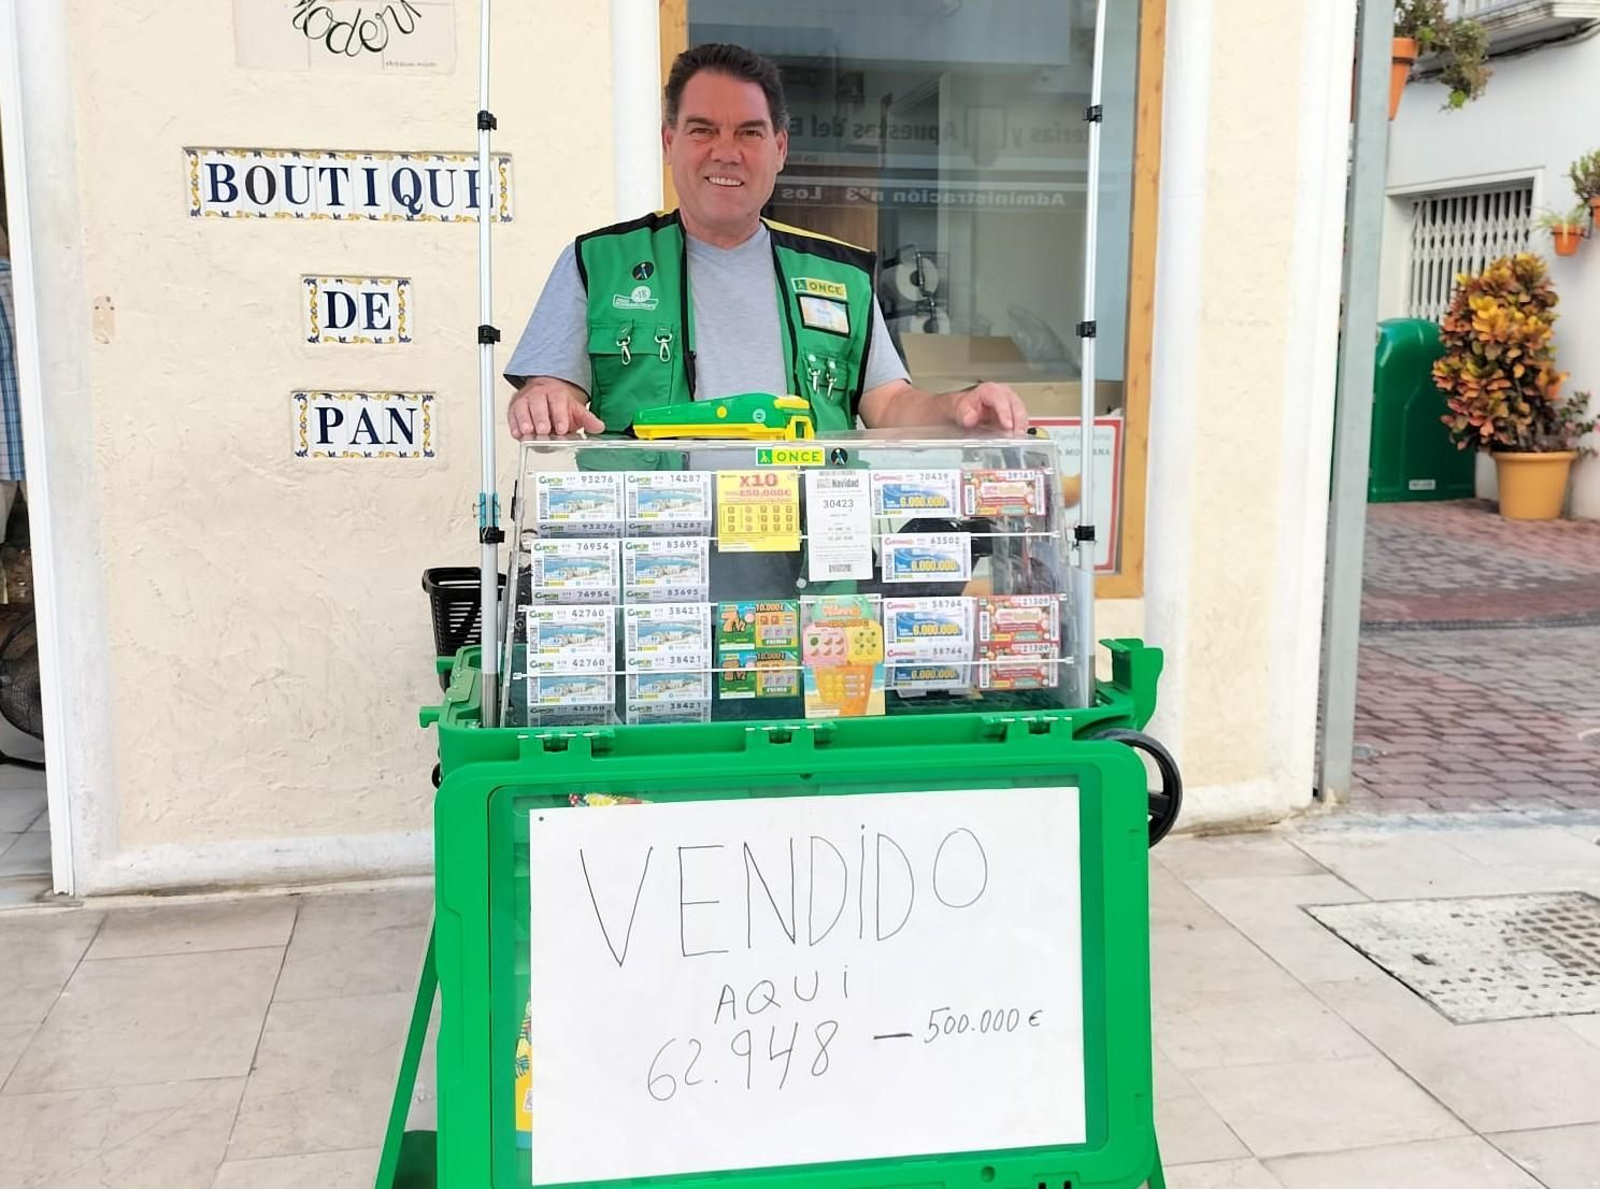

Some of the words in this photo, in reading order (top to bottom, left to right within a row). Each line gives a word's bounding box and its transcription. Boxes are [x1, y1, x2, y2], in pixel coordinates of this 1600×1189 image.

[204, 162, 495, 215] BOUTIQUE
[808, 281, 845, 296] ONCE
[322, 290, 392, 330] DE
[314, 406, 418, 445] PAN
[776, 451, 821, 462] ONCE
[580, 475, 614, 484] 93276
[831, 478, 860, 488] Navidad
[822, 499, 855, 509] 30423
[576, 542, 610, 551] 76954
[666, 540, 699, 549] 83695
[571, 609, 605, 617] 42760
[668, 606, 701, 615] 38421
[572, 658, 605, 667] 42760
[670, 655, 702, 664] 38421
[579, 823, 988, 968] VENDIDO
[713, 963, 848, 1025] AQUI
[647, 1020, 839, 1101] 62.948
